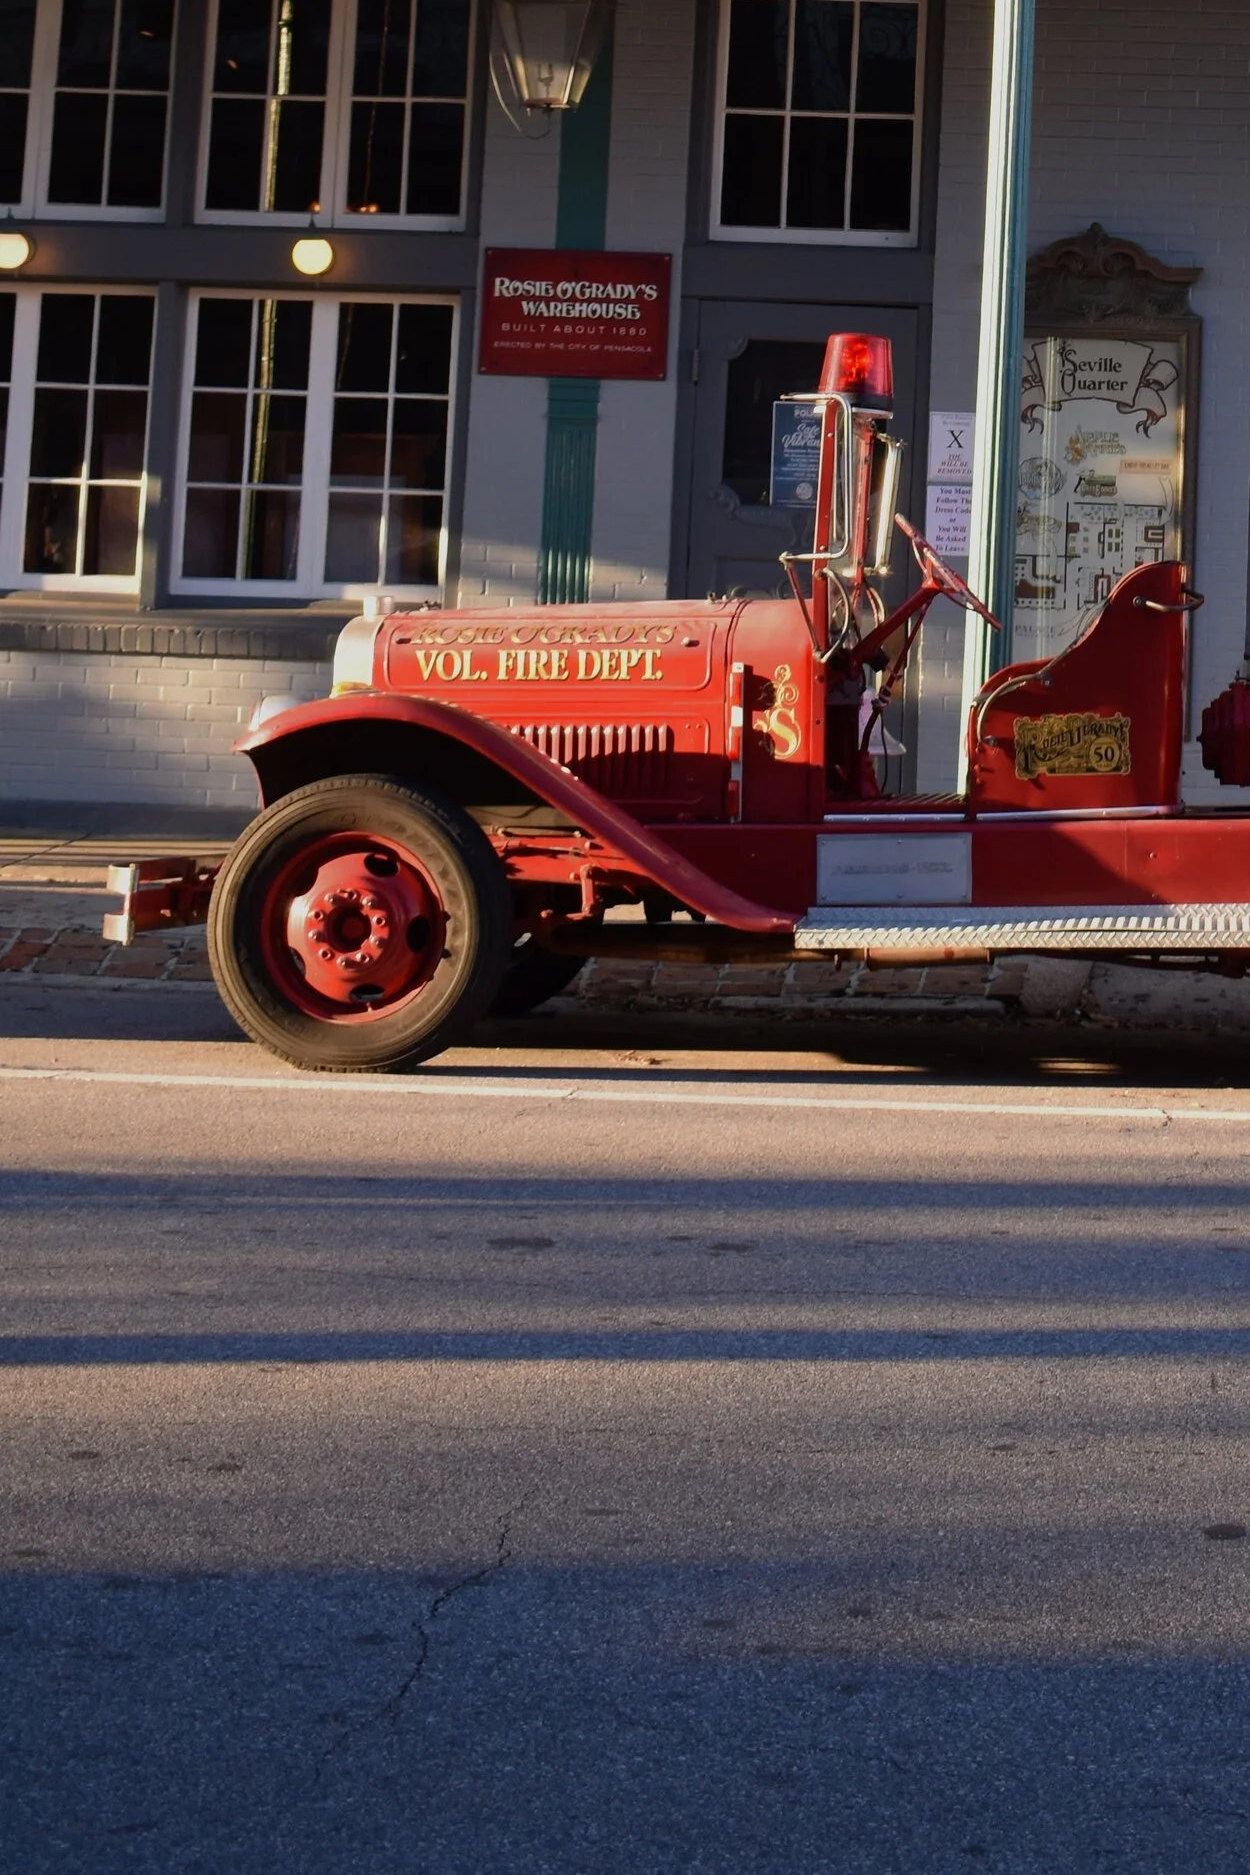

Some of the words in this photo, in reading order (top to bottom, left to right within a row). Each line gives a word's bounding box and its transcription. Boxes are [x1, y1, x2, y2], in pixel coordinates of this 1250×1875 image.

[493, 276, 554, 298] ROSIE
[556, 280, 658, 301] O'GRADY'S
[521, 300, 641, 320] WAREHOUSE
[501, 322, 546, 332] BUILT
[553, 324, 606, 334] ABOUT
[613, 327, 647, 336] 1880
[493, 340, 532, 349] ERECTED
[535, 341, 546, 349] BY
[550, 342, 564, 350] THE
[604, 344, 652, 353] PENSACOLA
[1062, 348, 1122, 373] Seville
[1061, 369, 1128, 396] Quarter
[947, 429, 964, 448] X
[410, 624, 506, 646] ROSIE
[415, 649, 488, 681] VOL.
[496, 649, 569, 681] FIRE
[576, 648, 663, 681] DEPT.
[1093, 745, 1115, 763] 50
